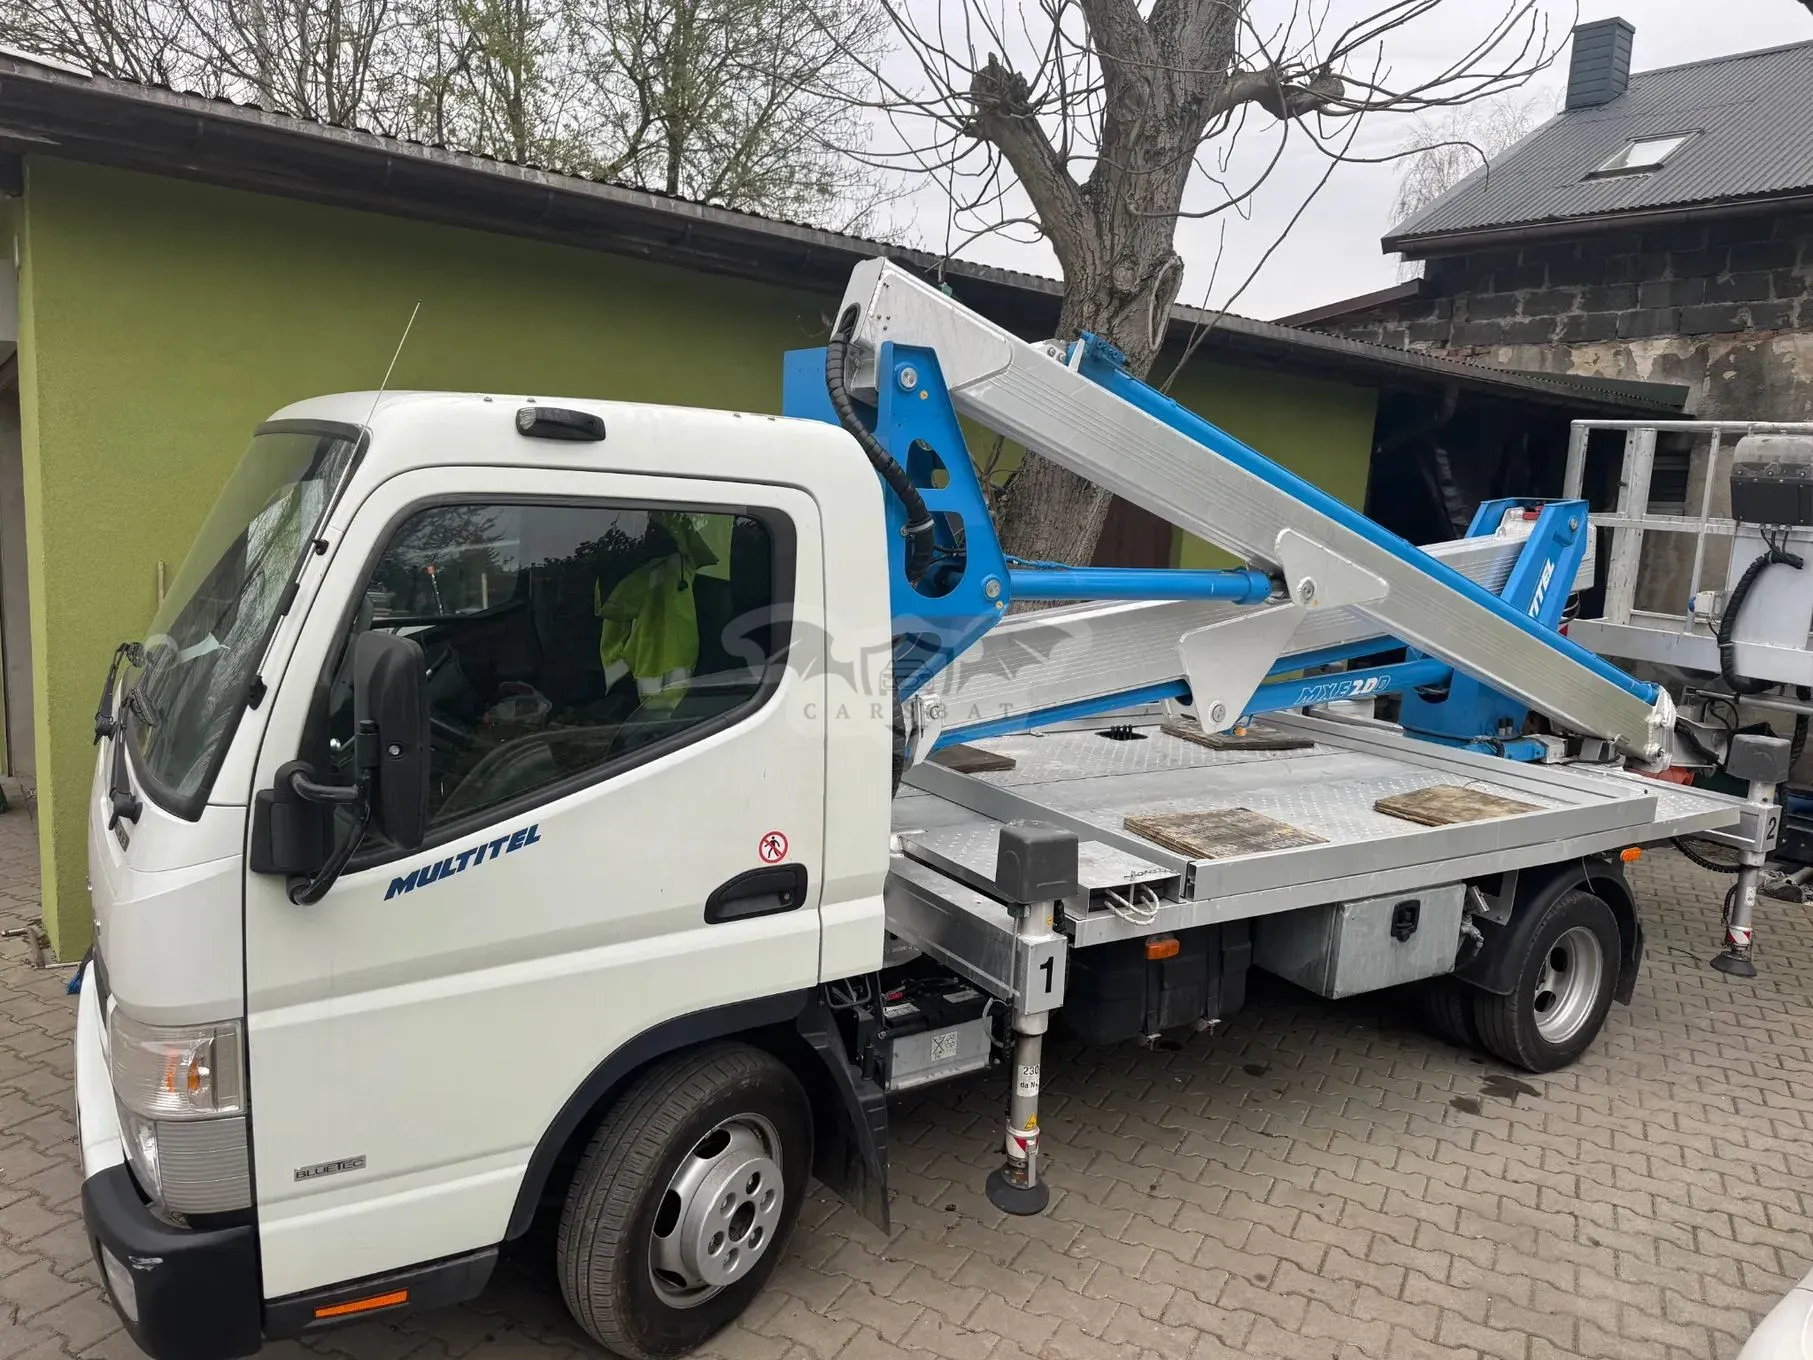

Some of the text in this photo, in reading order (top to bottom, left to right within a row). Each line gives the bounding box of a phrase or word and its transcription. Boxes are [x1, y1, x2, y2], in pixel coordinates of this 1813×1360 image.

[1766, 816, 1777, 841] 2
[384, 824, 541, 901] MULTITEL
[1040, 956, 1054, 993] 1
[296, 1159, 364, 1178] BLUETEC
